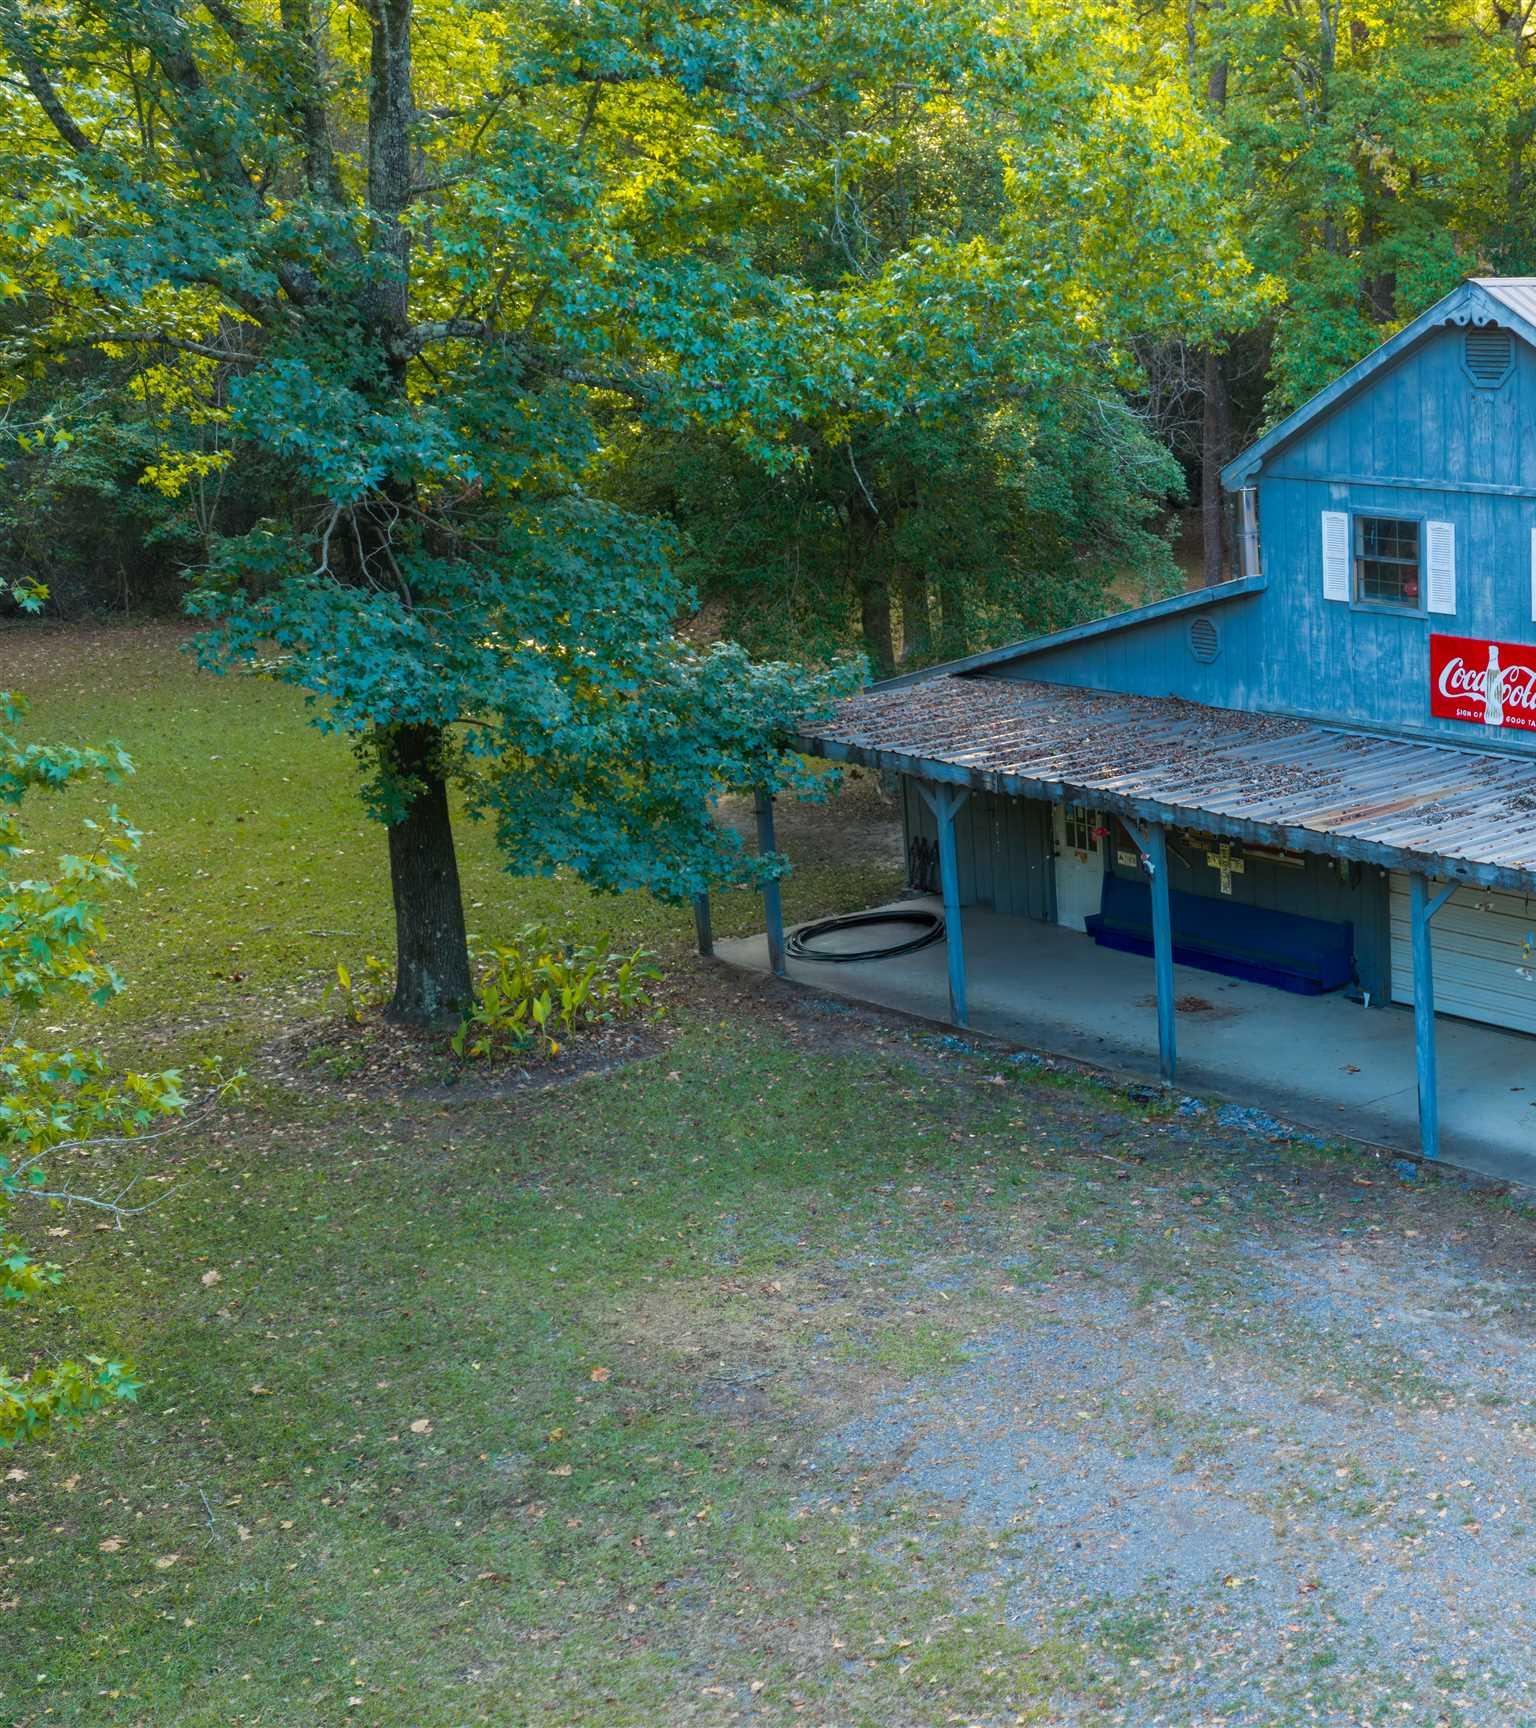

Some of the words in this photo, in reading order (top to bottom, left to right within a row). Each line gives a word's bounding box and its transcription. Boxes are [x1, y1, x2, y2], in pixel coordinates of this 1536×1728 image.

[1456, 708, 1472, 718] SIGN
[1473, 711, 1483, 719] OF
[1505, 715, 1526, 725] GOOD
